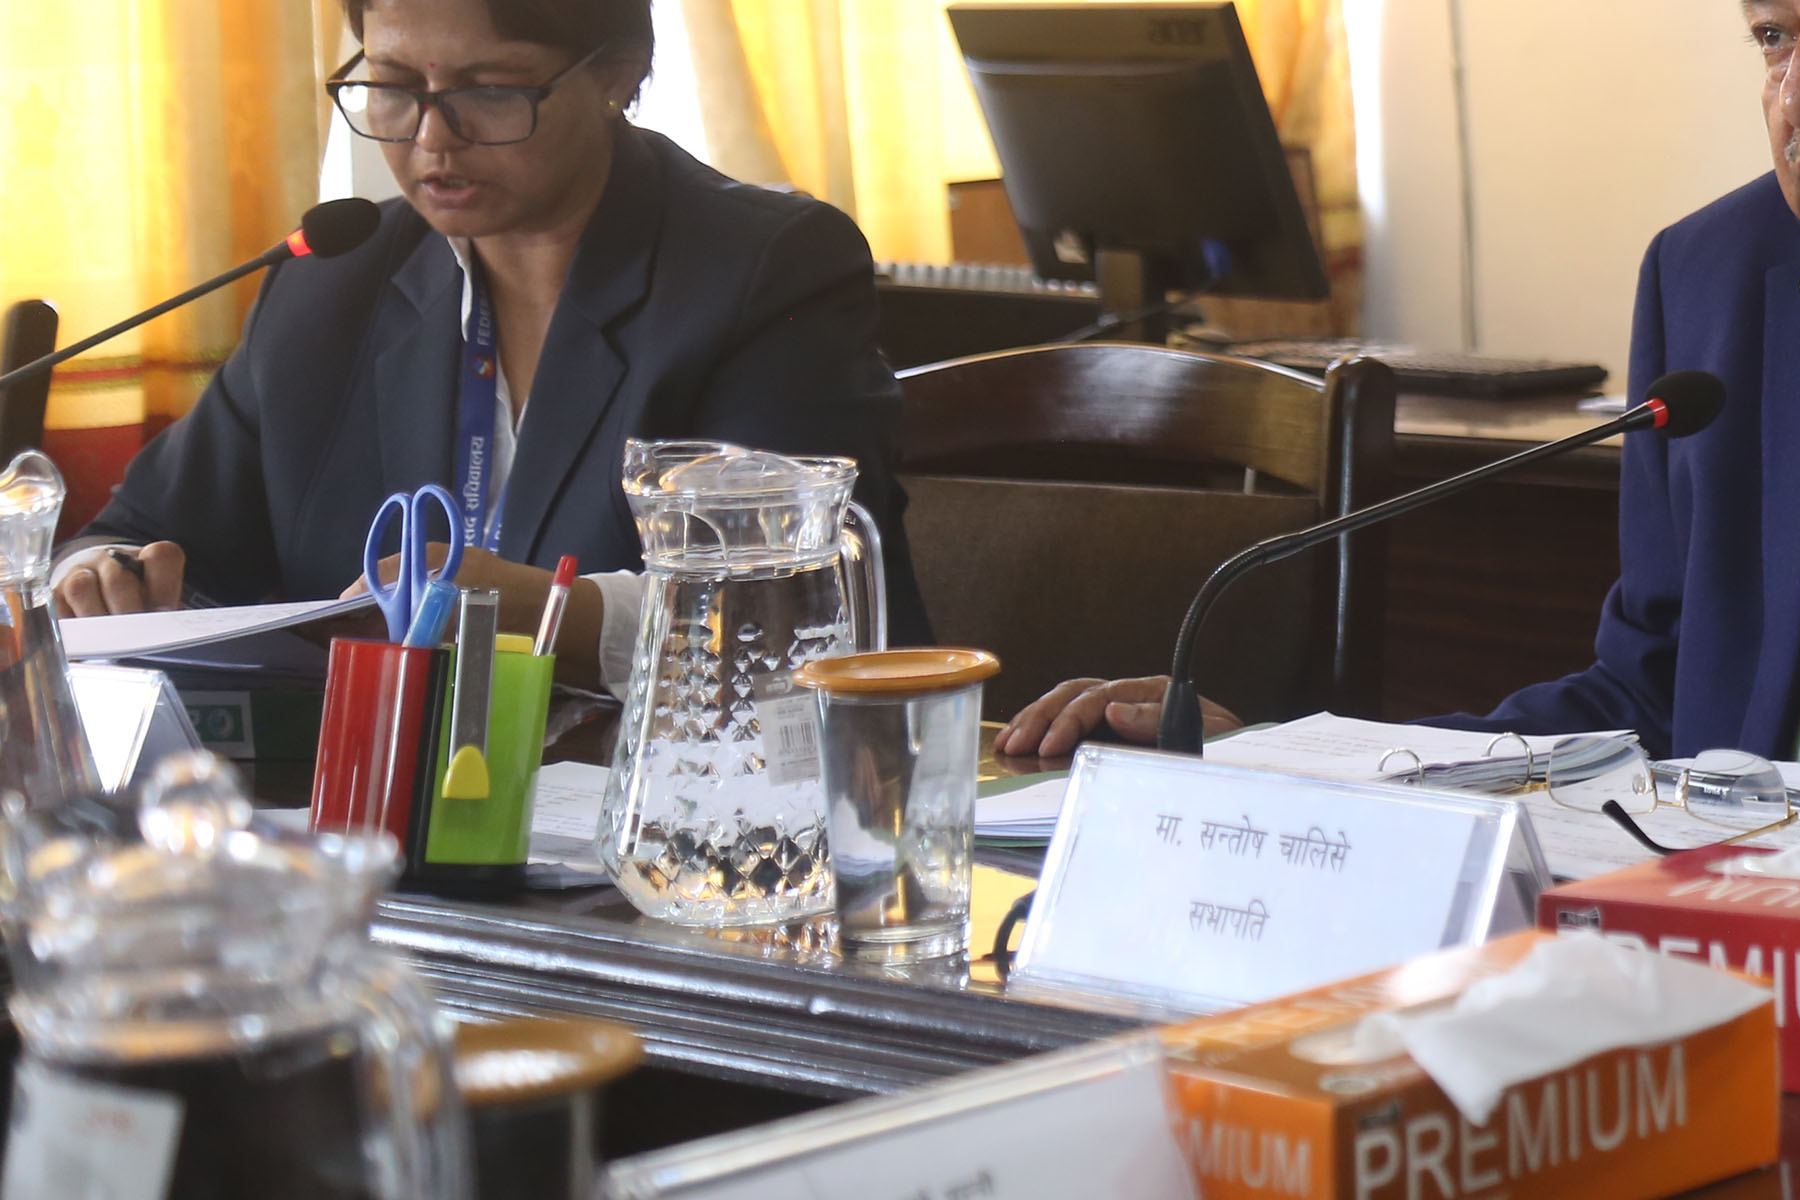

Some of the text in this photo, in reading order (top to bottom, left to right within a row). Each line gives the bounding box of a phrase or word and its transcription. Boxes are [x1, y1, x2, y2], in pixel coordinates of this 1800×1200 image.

[1156, 813, 1352, 872] मा. सन्तोष चालिसे
[1189, 899, 1270, 941] सभापति
[1354, 1044, 1686, 1200] PREMIUM
[1178, 1117, 1312, 1199] MIUM
